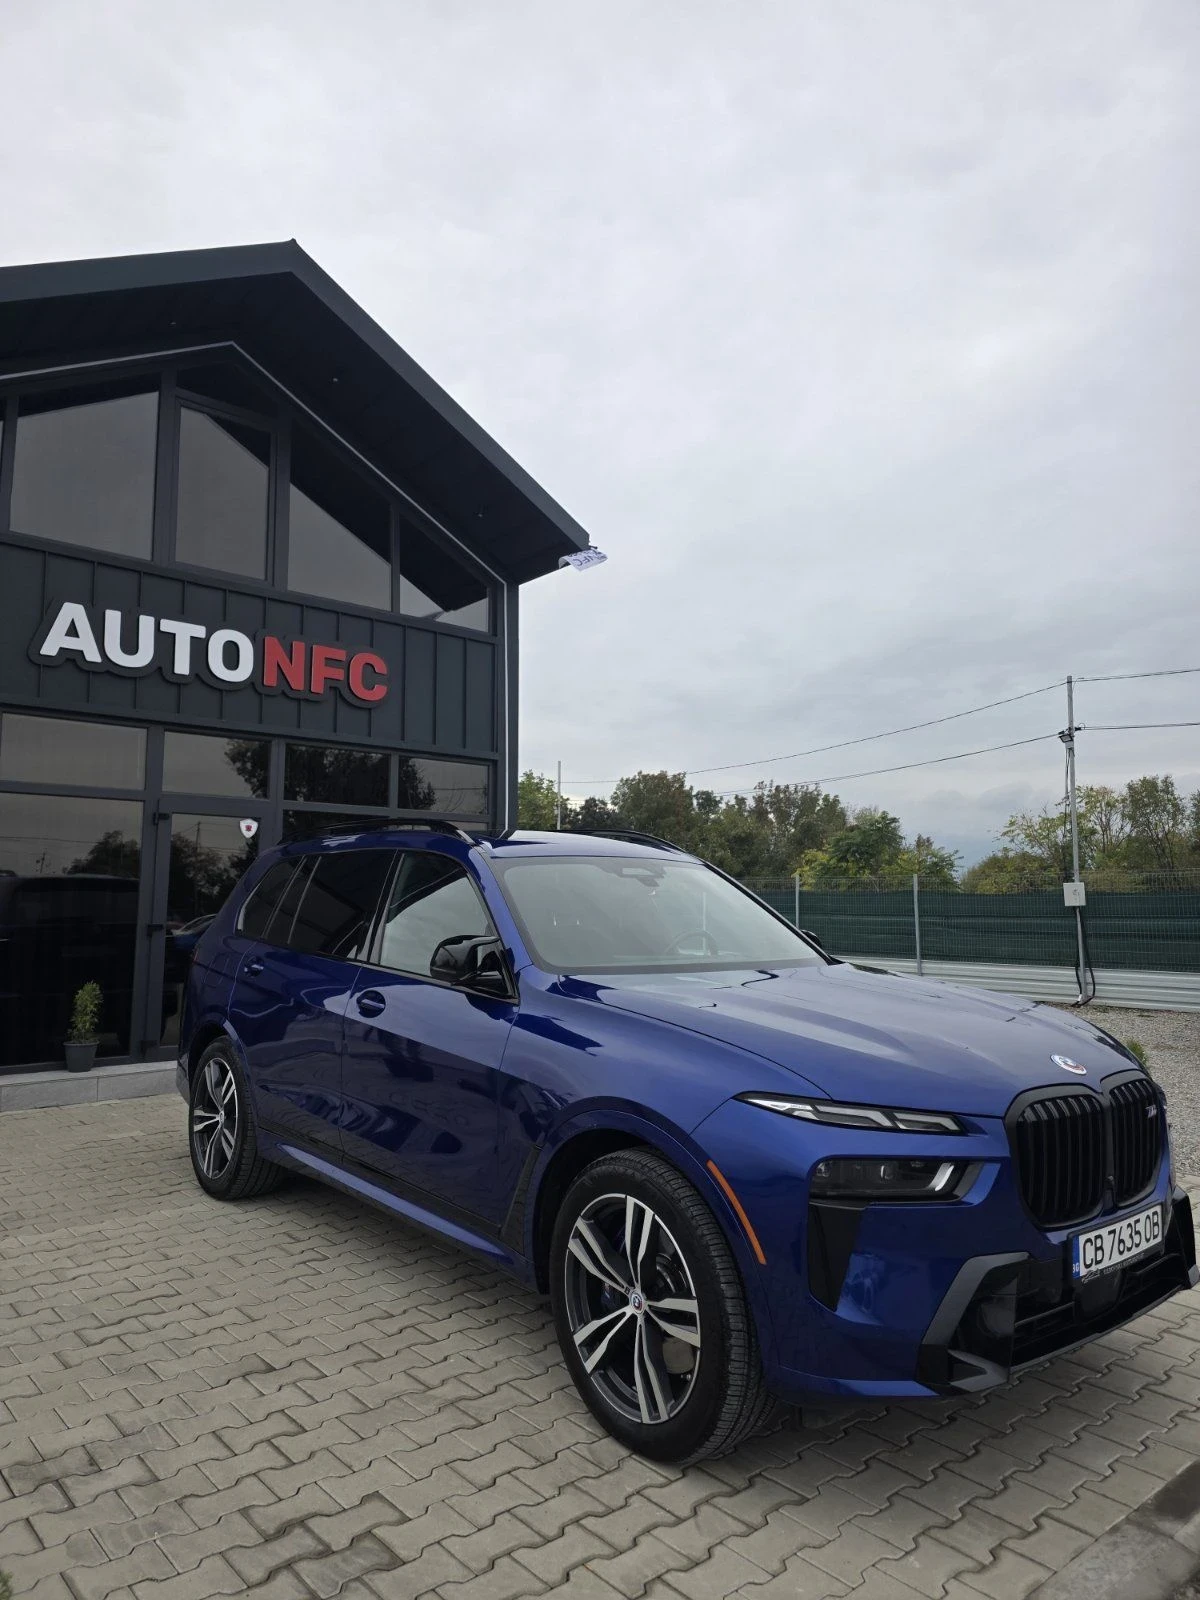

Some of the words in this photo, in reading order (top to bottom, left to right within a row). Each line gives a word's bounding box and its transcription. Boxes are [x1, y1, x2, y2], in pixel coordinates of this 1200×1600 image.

[1083, 1234, 1104, 1269] CB
[1108, 1218, 1142, 1261] 7635
[1144, 1210, 1160, 1243] OB
